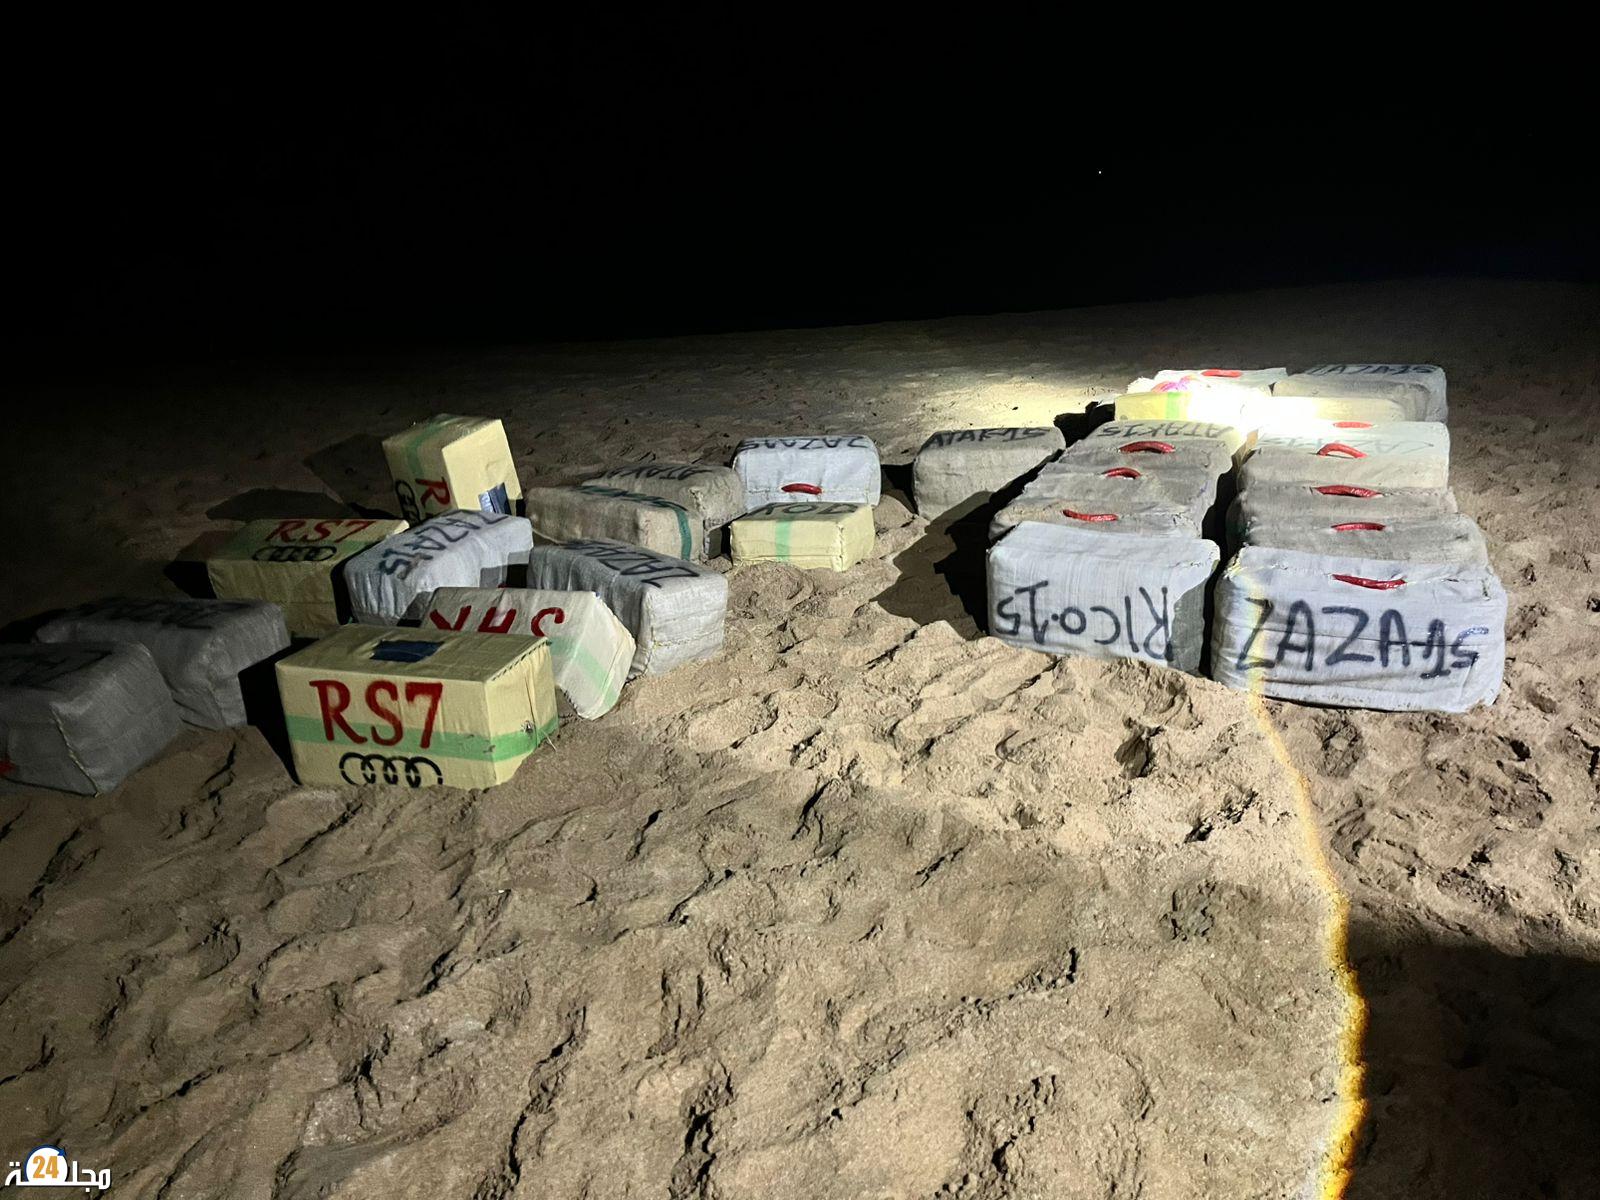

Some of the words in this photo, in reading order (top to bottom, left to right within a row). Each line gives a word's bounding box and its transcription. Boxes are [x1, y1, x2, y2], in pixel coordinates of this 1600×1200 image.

[265, 519, 376, 544] RS7
[1235, 597, 1489, 679] ZAZA-15
[309, 680, 443, 749] RS7
